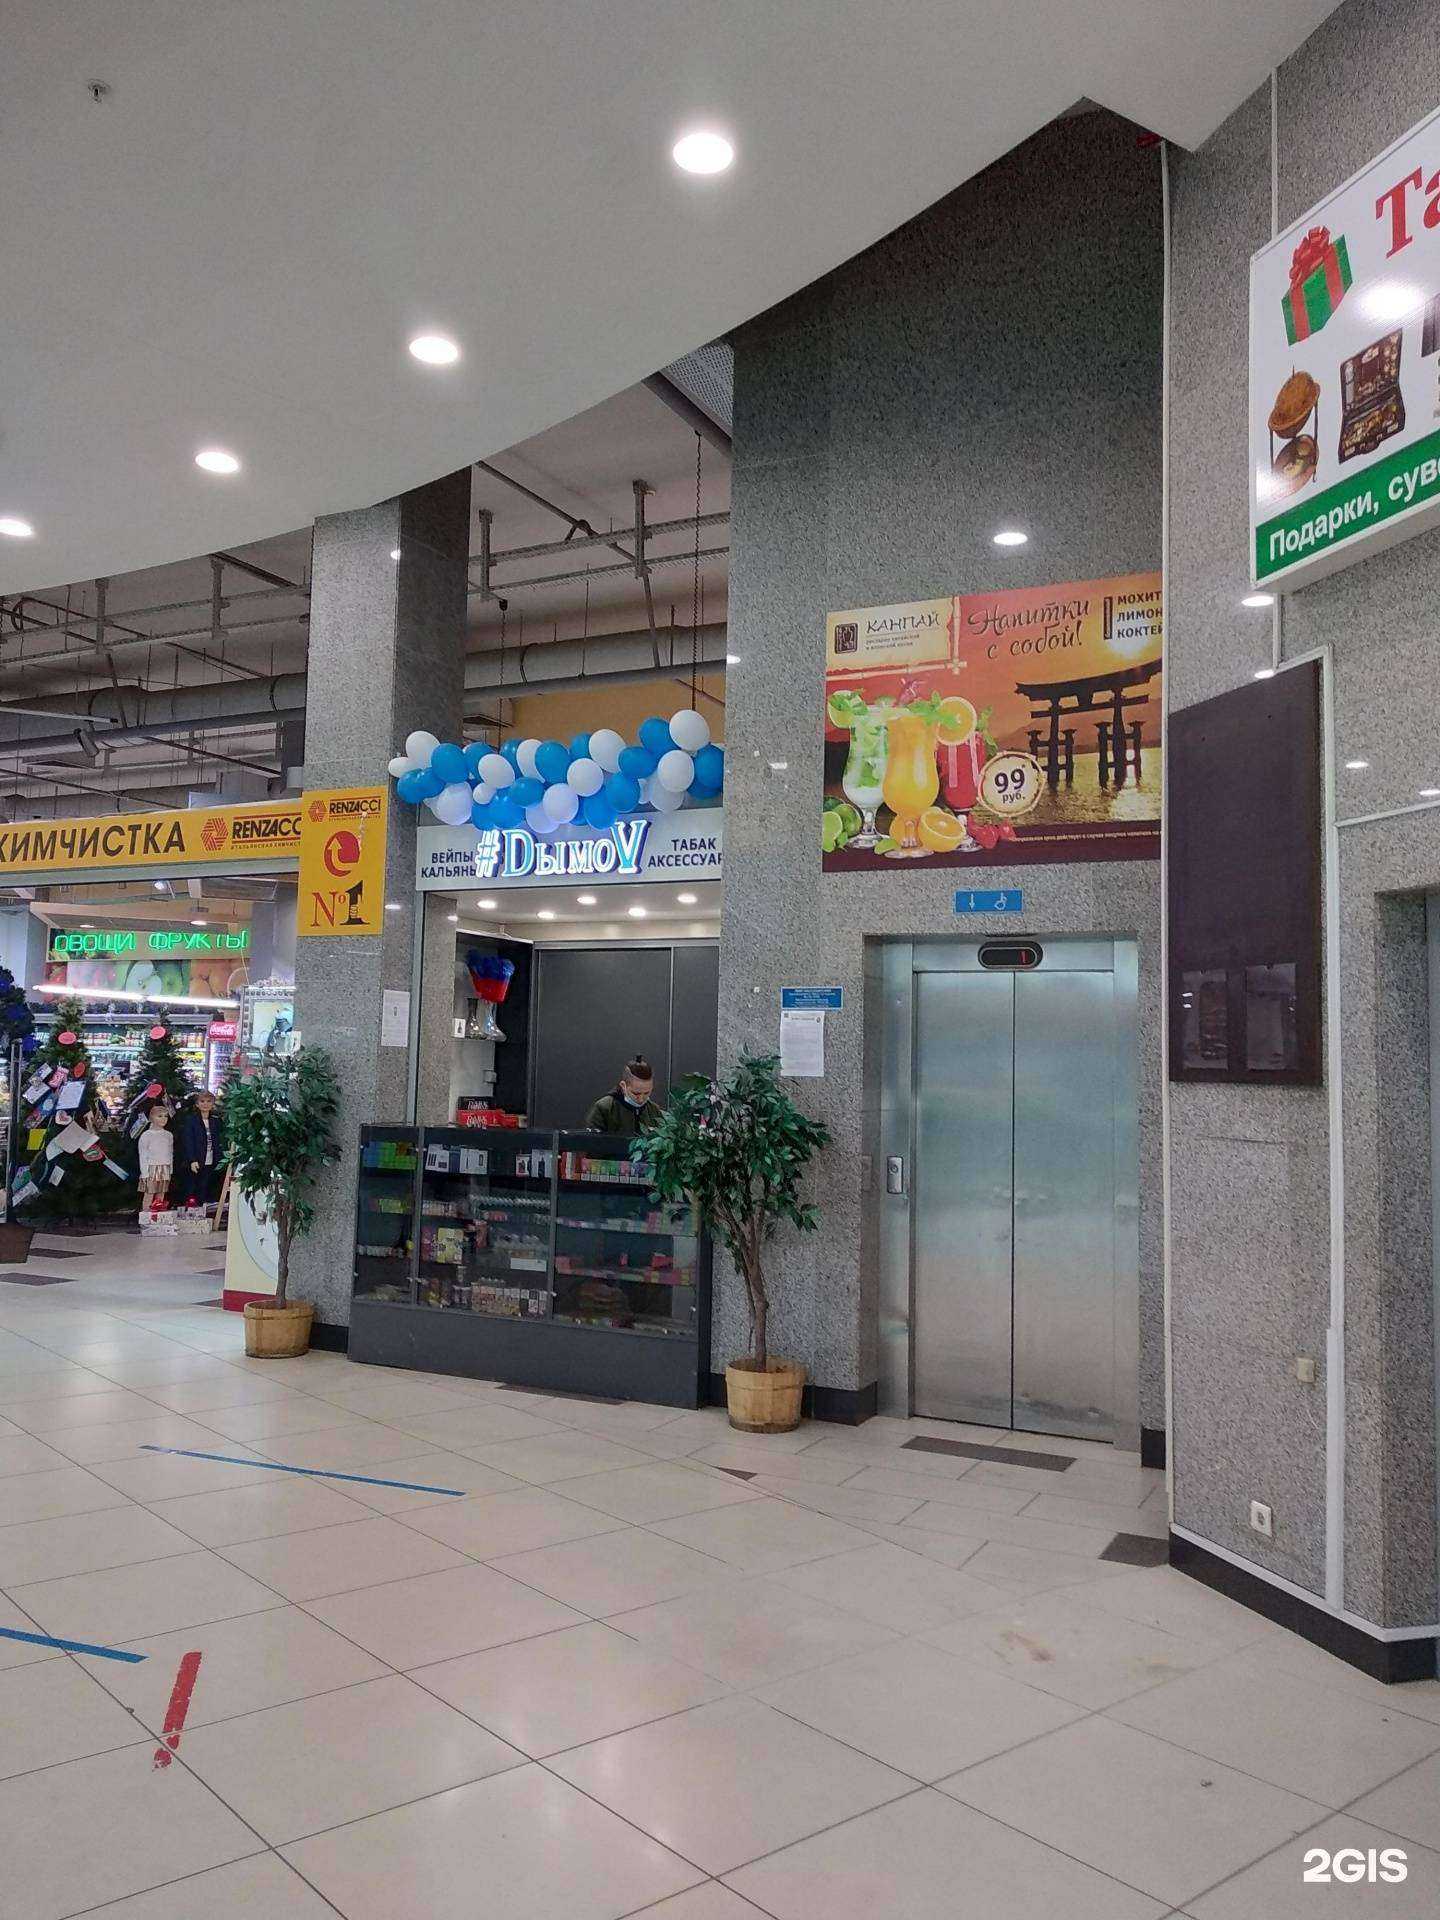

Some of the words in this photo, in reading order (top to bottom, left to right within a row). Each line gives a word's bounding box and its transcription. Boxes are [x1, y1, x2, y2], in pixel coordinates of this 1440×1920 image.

[1268, 490, 1380, 562] Подарки,
[1387, 455, 1440, 503] сув
[1117, 590, 1162, 606] МОХИТ
[865, 610, 941, 634] КАНПАЙ
[967, 599, 1090, 636] Напитки
[1116, 607, 1163, 623] ЛИМОН
[1009, 620, 1083, 657] собой!
[1002, 791, 1026, 804] руб.
[329, 799, 381, 815] RENZACCI
[671, 837, 717, 851] ТАБАК
[431, 848, 473, 864] ВЕЙПЫ
[54, 931, 136, 955] ОВОЩИ
